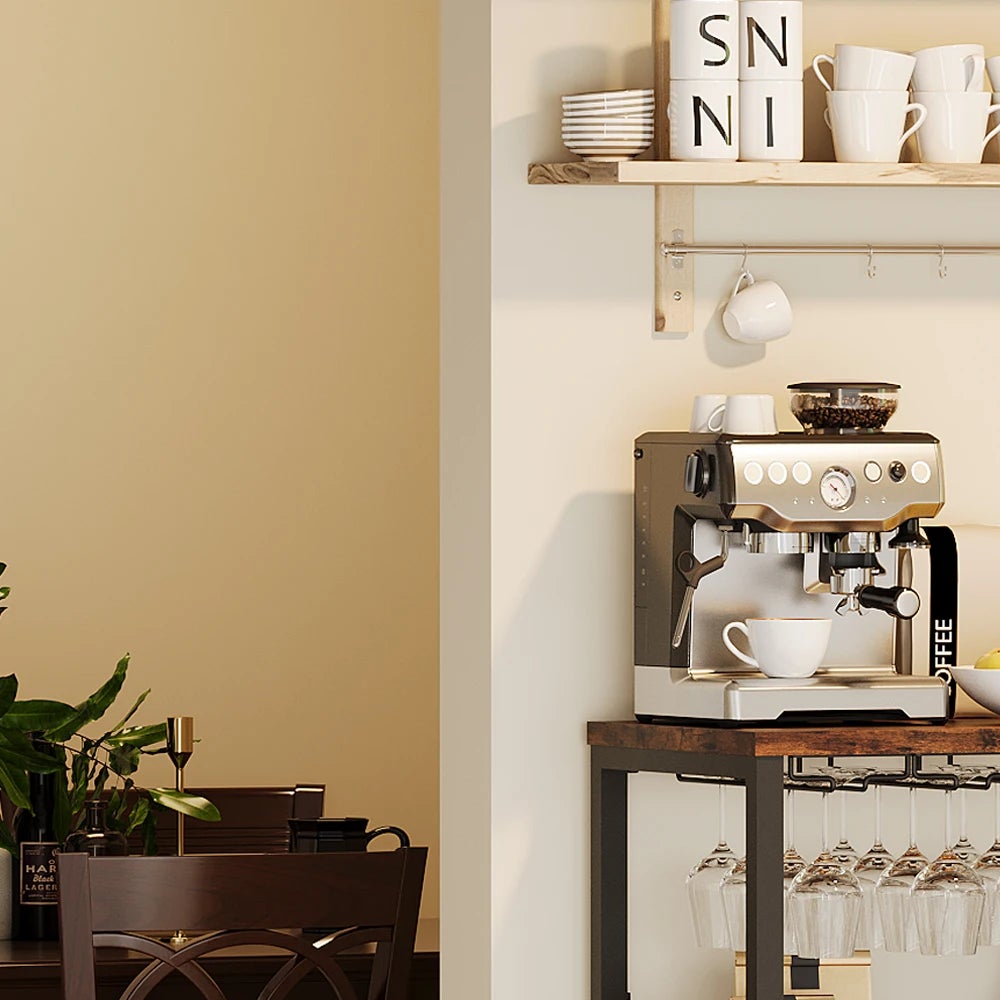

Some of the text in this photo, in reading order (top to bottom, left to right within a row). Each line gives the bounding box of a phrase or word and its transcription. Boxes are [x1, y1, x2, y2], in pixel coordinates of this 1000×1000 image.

[699, 14, 730, 66] S
[746, 16, 787, 67] N
[692, 95, 732, 146] N
[766, 97, 774, 147] I
[935, 619, 952, 696] OFFEE
